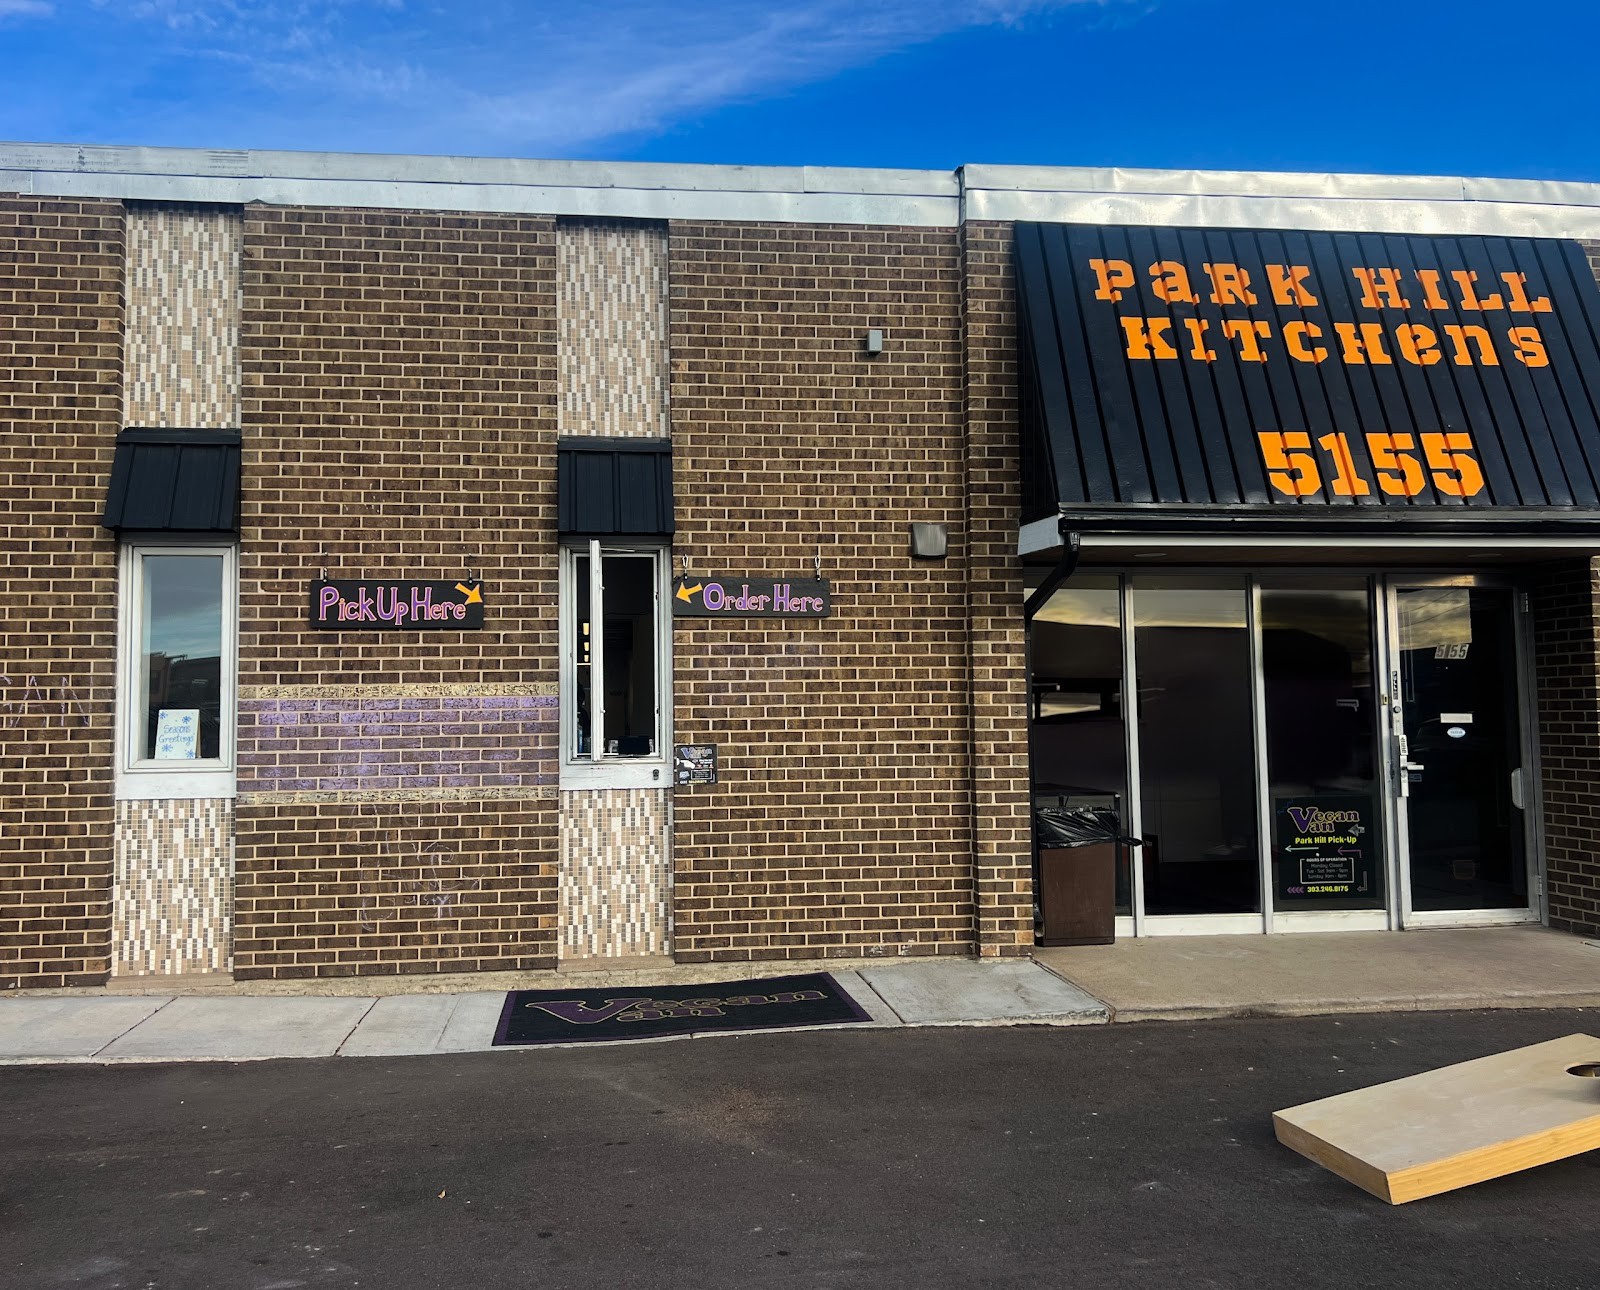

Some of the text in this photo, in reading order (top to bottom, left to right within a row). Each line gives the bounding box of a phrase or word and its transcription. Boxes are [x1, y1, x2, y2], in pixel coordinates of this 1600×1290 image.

[1351, 267, 1553, 314] HILL
[1257, 431, 1485, 499] 5155
[319, 586, 466, 625] Pick Up Here
[702, 582, 824, 612] Order Here
[1287, 807, 1360, 833] Vegan
[1314, 836, 1327, 844] Hill
[1328, 836, 1357, 844] Pick-Up
[525, 989, 828, 1024] Vegan
